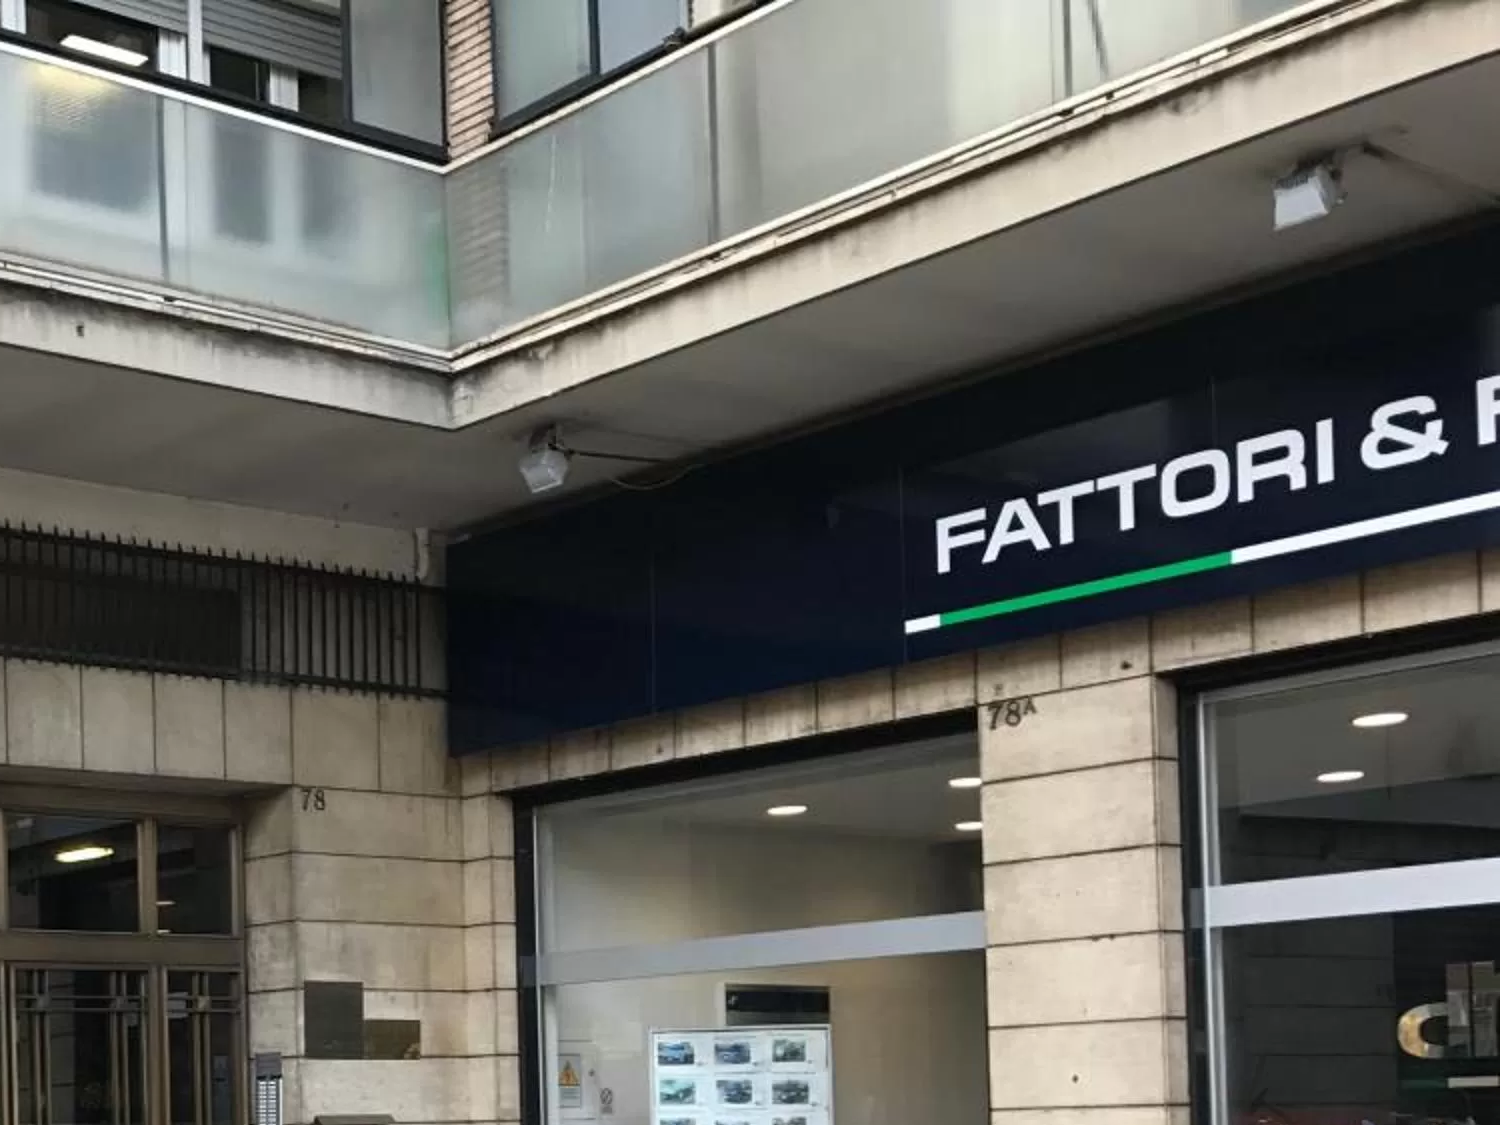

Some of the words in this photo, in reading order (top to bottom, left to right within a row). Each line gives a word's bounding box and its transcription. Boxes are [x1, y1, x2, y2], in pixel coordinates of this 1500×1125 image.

[935, 417, 1334, 573] FATTORI
[1360, 395, 1449, 471] &
[301, 788, 325, 811] 78
